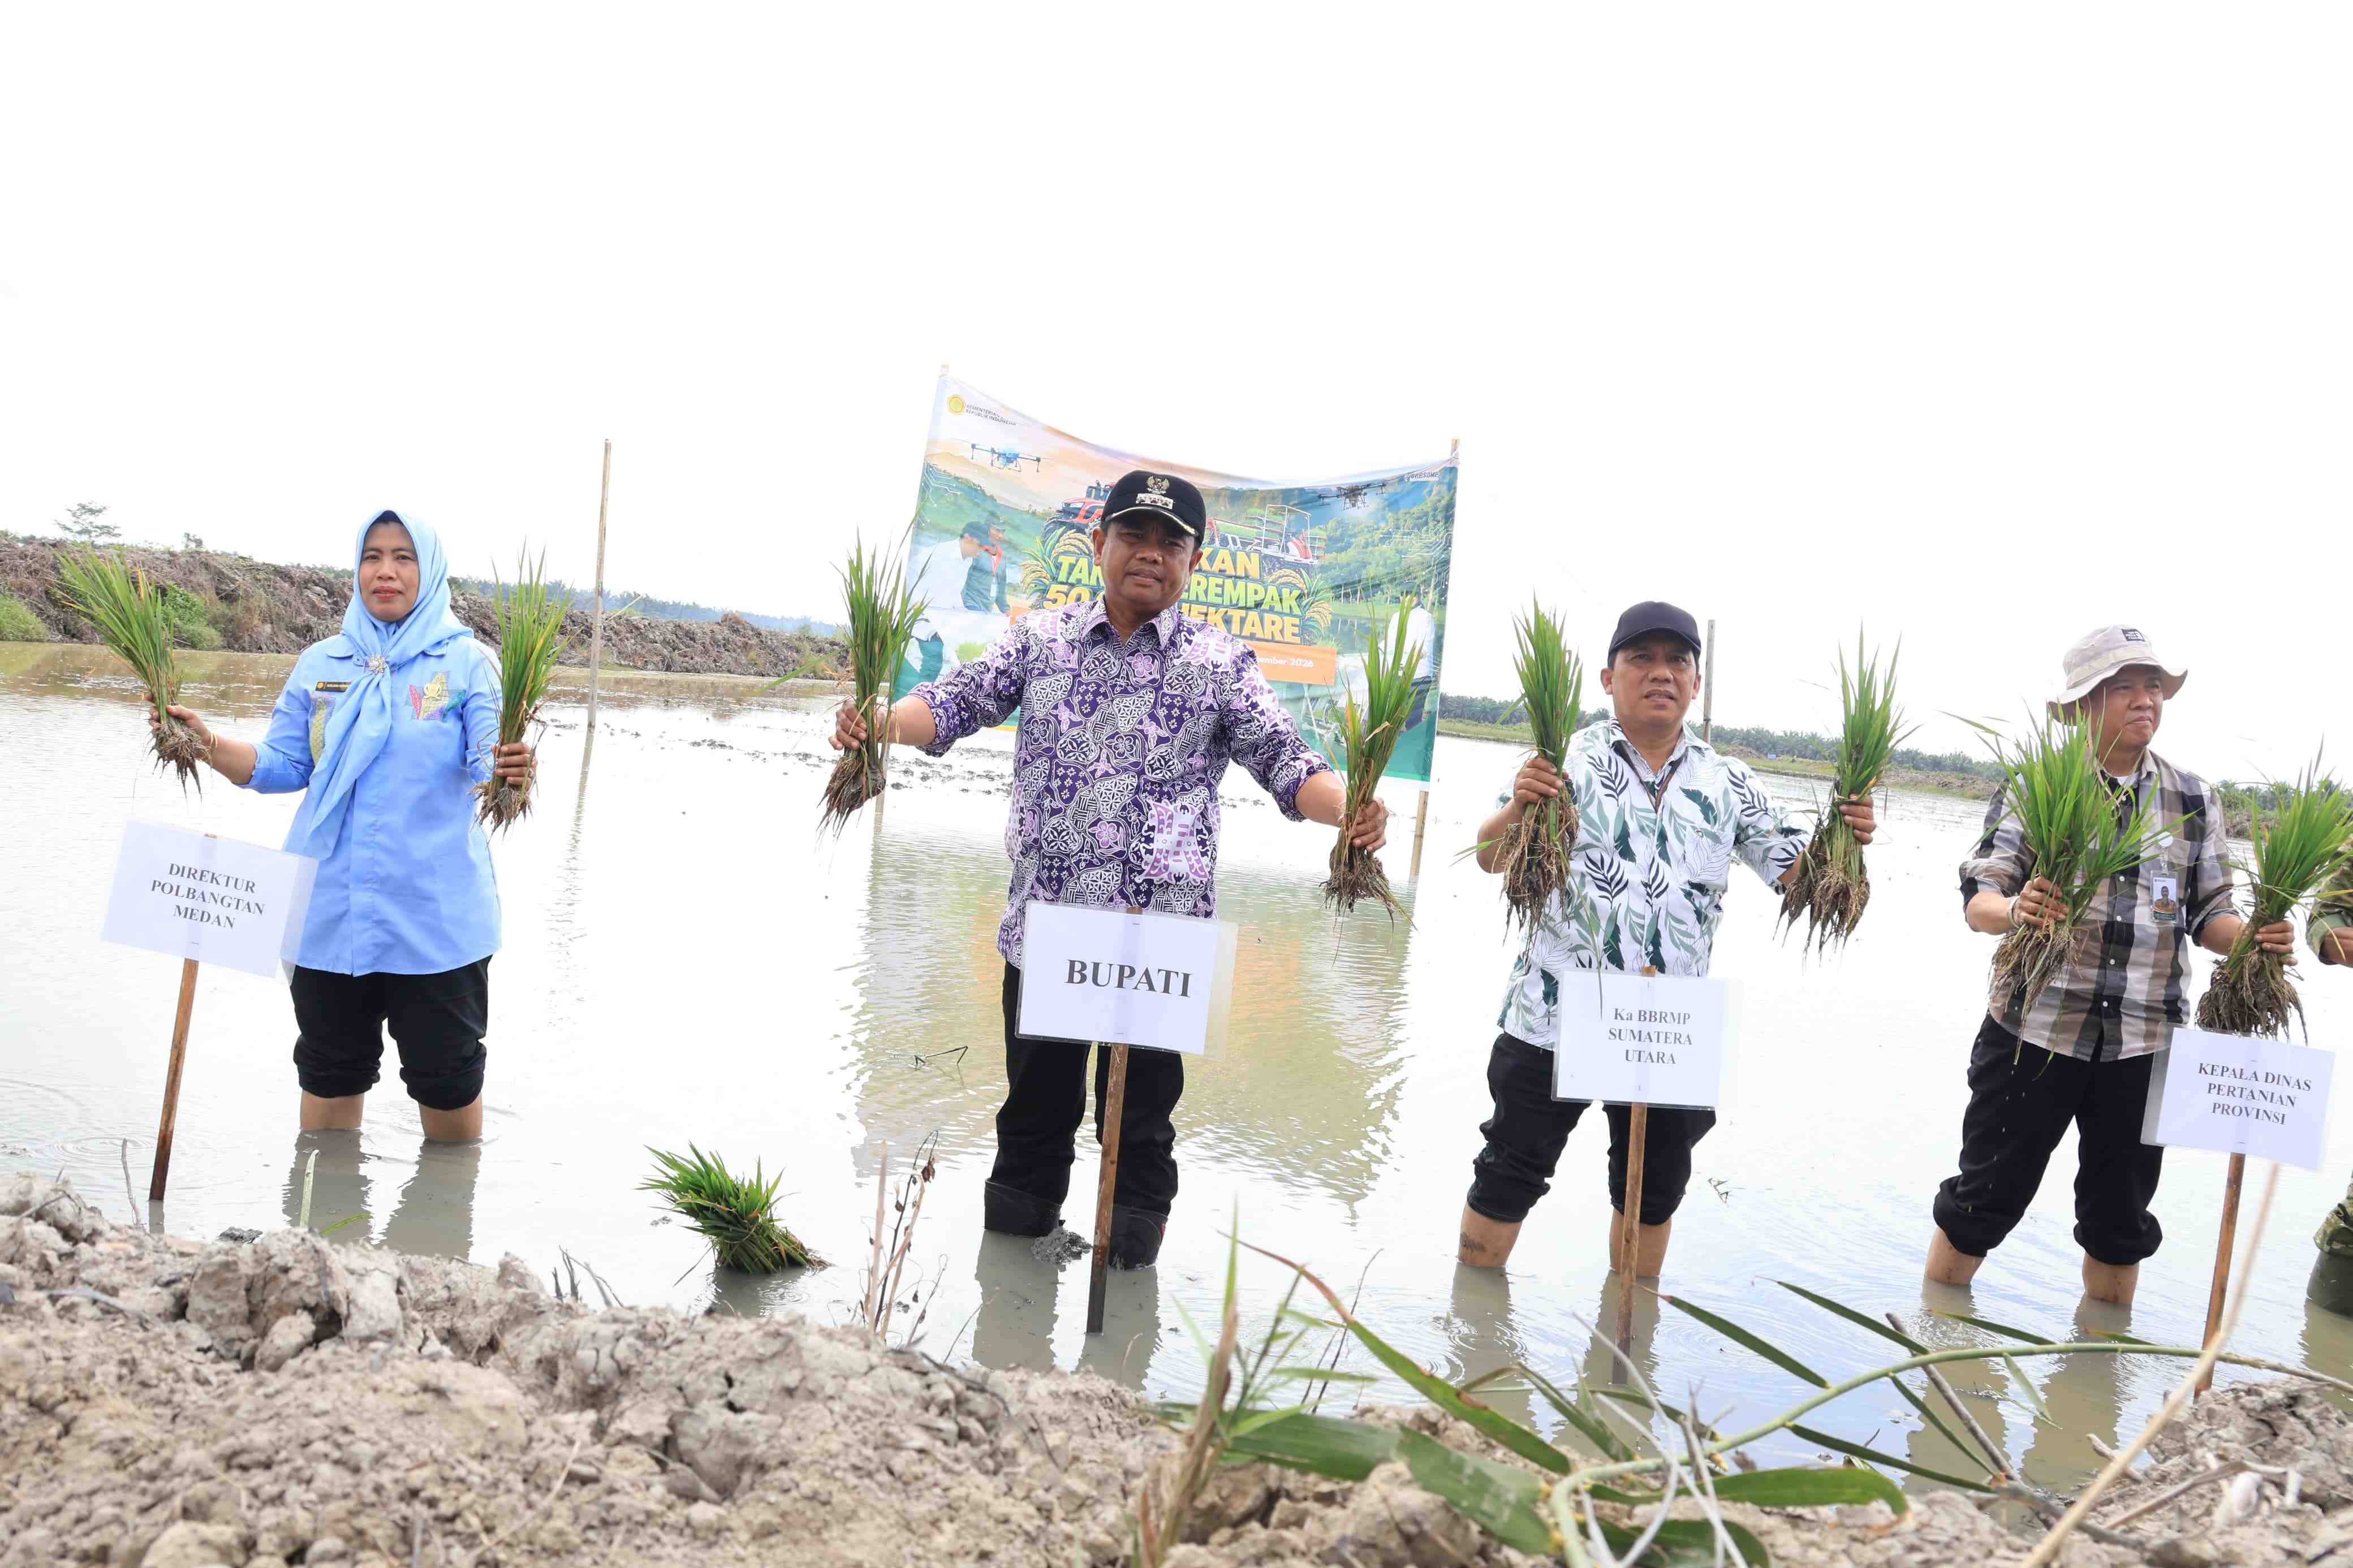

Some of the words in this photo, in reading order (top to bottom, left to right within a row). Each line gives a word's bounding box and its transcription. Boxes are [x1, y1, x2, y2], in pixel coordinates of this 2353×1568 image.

[168, 863, 256, 893] DIREKTUR
[151, 879, 266, 916] POLBANGTAN
[173, 905, 236, 930] MEDAN
[1065, 959, 1193, 998] BUPATI
[1614, 1008, 1633, 1021] Ka
[1638, 1009, 1691, 1025] BBRMP
[1608, 1027, 1692, 1046] SUMATERA
[1624, 1049, 1677, 1065] UTARA
[2199, 1062, 2259, 1082] KEPALA
[2264, 1072, 2312, 1091] DINAS
[2208, 1082, 2297, 1108] PERTANIAN
[2212, 1102, 2286, 1125] PROVINSI
